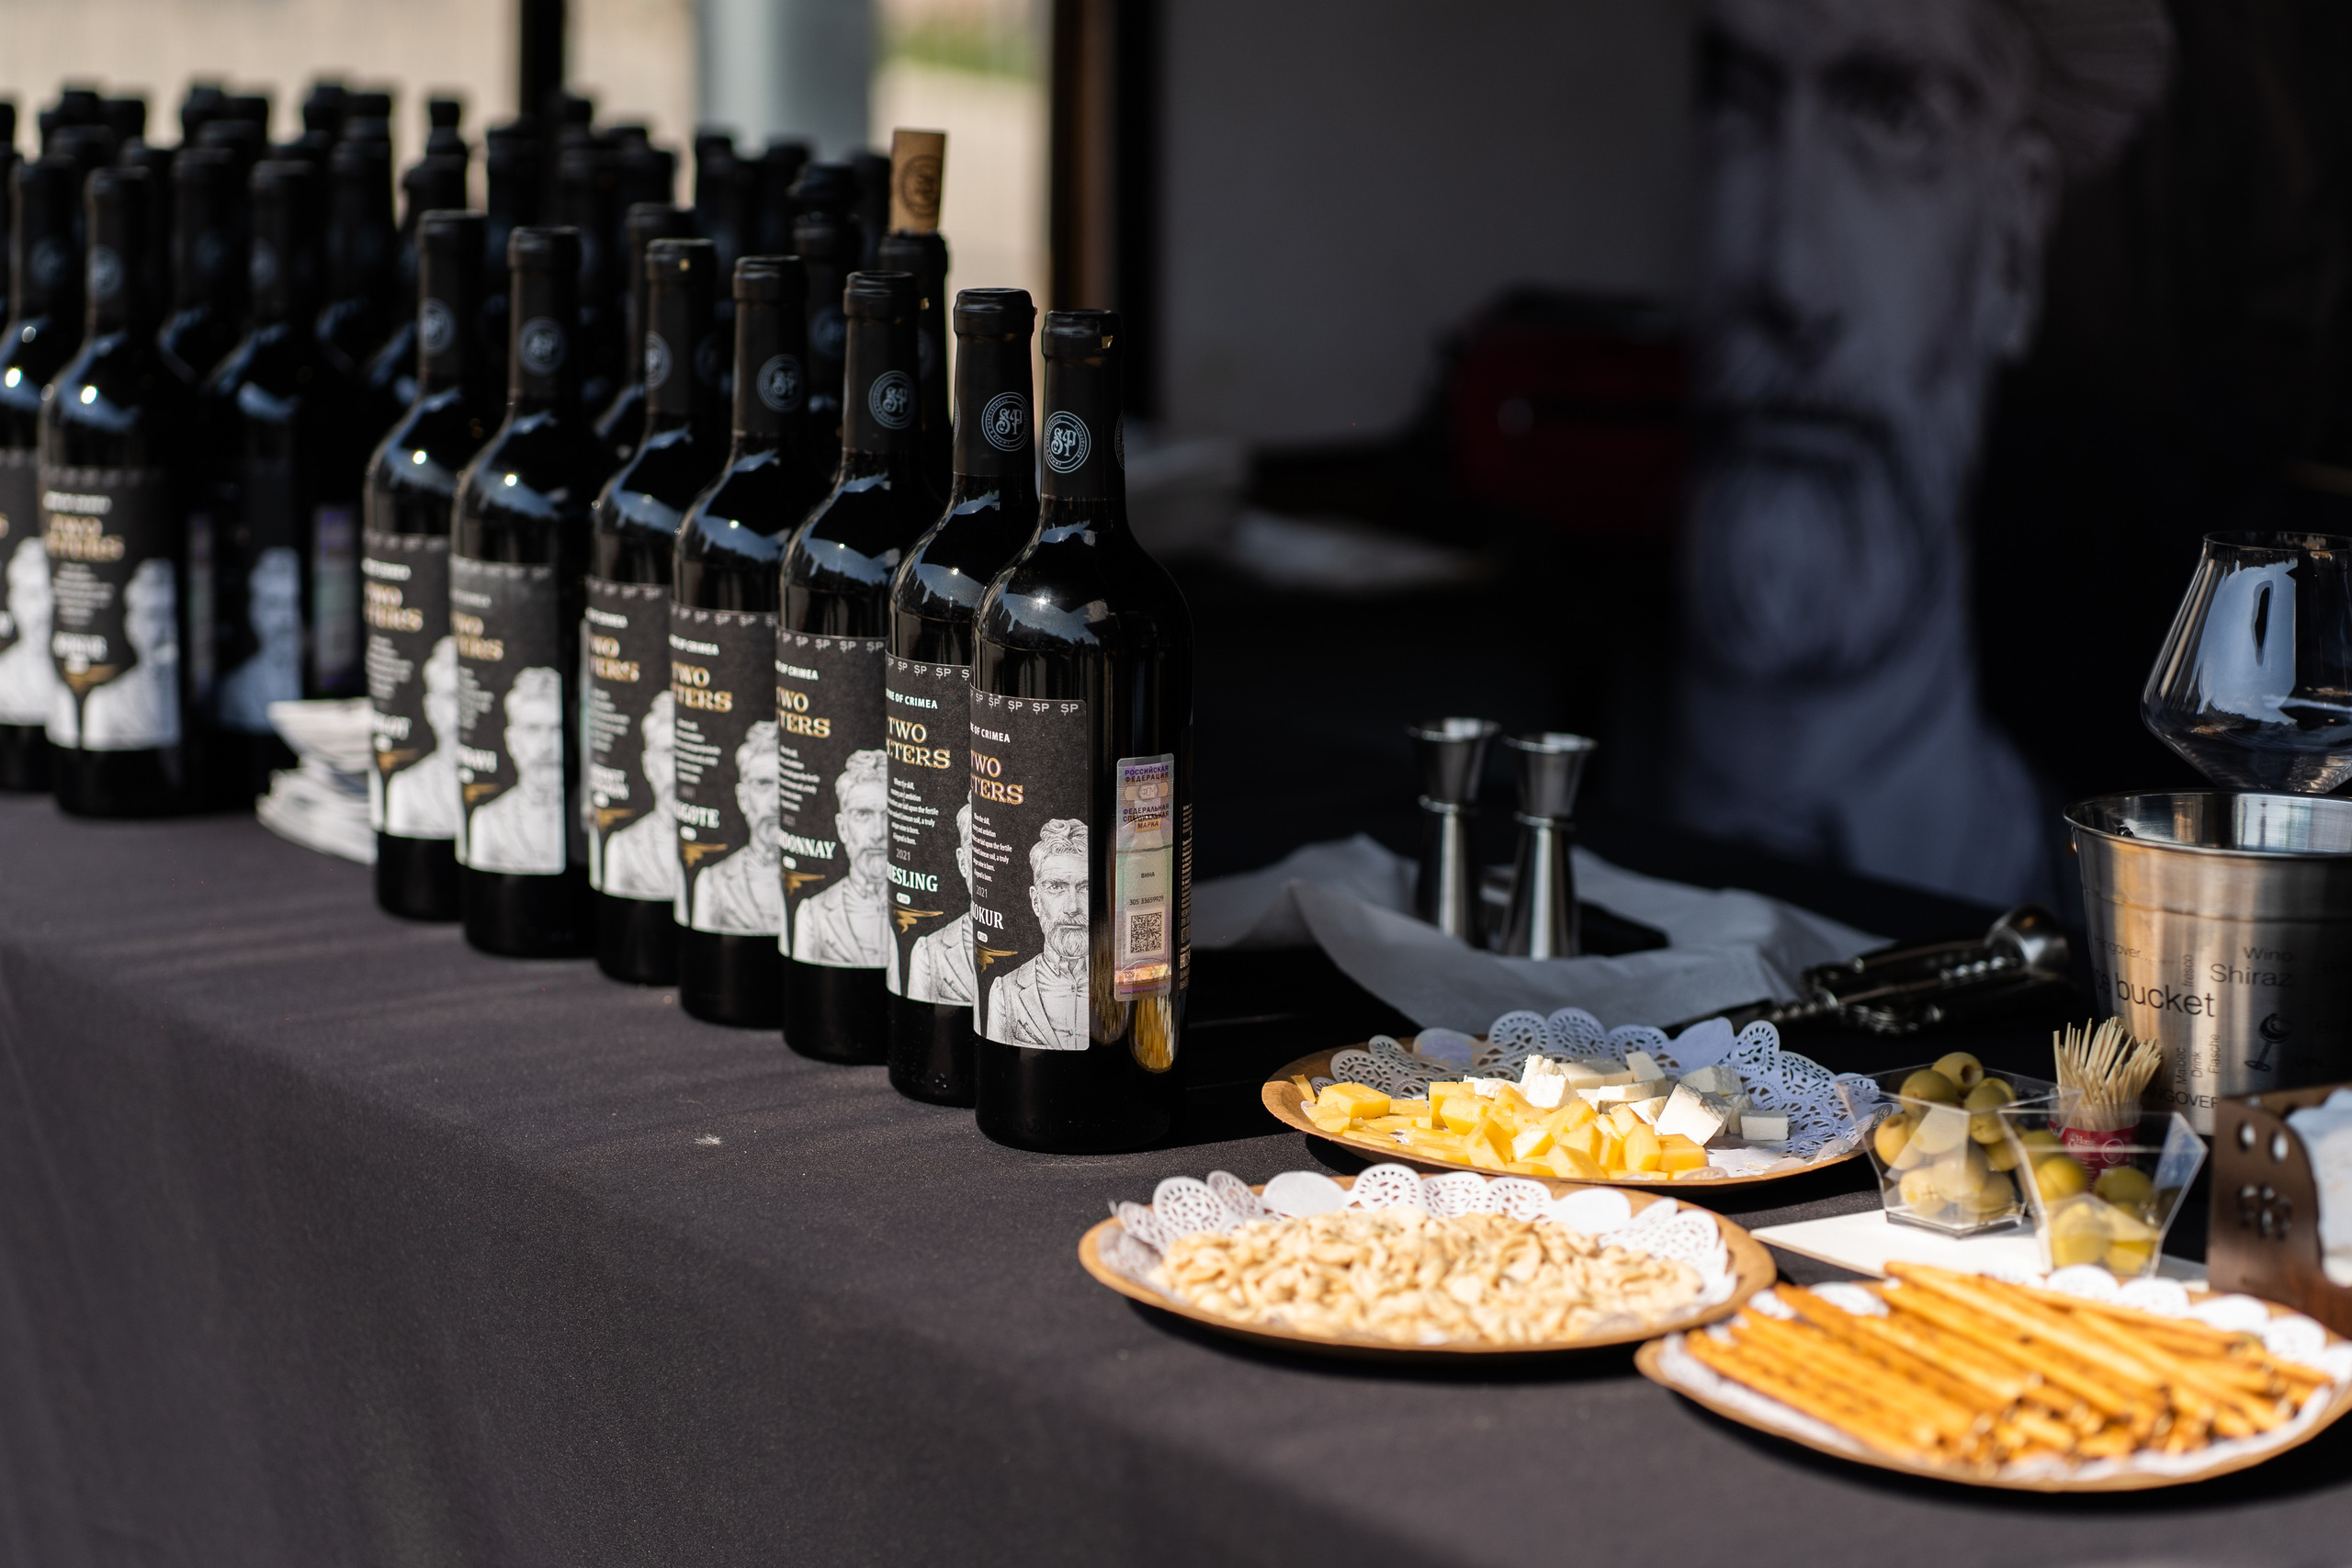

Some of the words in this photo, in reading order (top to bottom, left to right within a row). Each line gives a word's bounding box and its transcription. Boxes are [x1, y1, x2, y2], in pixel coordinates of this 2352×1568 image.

[996, 408, 1023, 434] SP
[1051, 427, 1077, 457] SP
[815, 638, 831, 651] SP
[840, 640, 856, 653] SP
[866, 641, 884, 654] SP
[898, 660, 908, 672] SP
[914, 664, 927, 677] SP
[935, 667, 952, 679] SP
[671, 682, 733, 713] TERS
[905, 695, 938, 710] CRIMEA
[989, 697, 1000, 709] SP
[1008, 700, 1023, 713] SP
[1033, 702, 1049, 715] SP
[1060, 704, 1079, 716] SP
[776, 707, 831, 739] TERS
[888, 716, 928, 744] TWO
[981, 728, 1011, 743] CRIMEA
[971, 748, 1002, 778] TWO
[1125, 764, 1169, 776] РОССИЙСКАЯ
[1125, 772, 1169, 783] ФЕДЕРАЦИЯ
[1123, 803, 1170, 815] ФЕДЕРАЛЬНАЯ
[1136, 820, 1159, 829] МАРКА
[896, 848, 910, 862] 2021
[976, 885, 988, 898] 2021
[2211, 964, 2294, 987] Shiraz
[2115, 972, 2216, 1018] bucket
